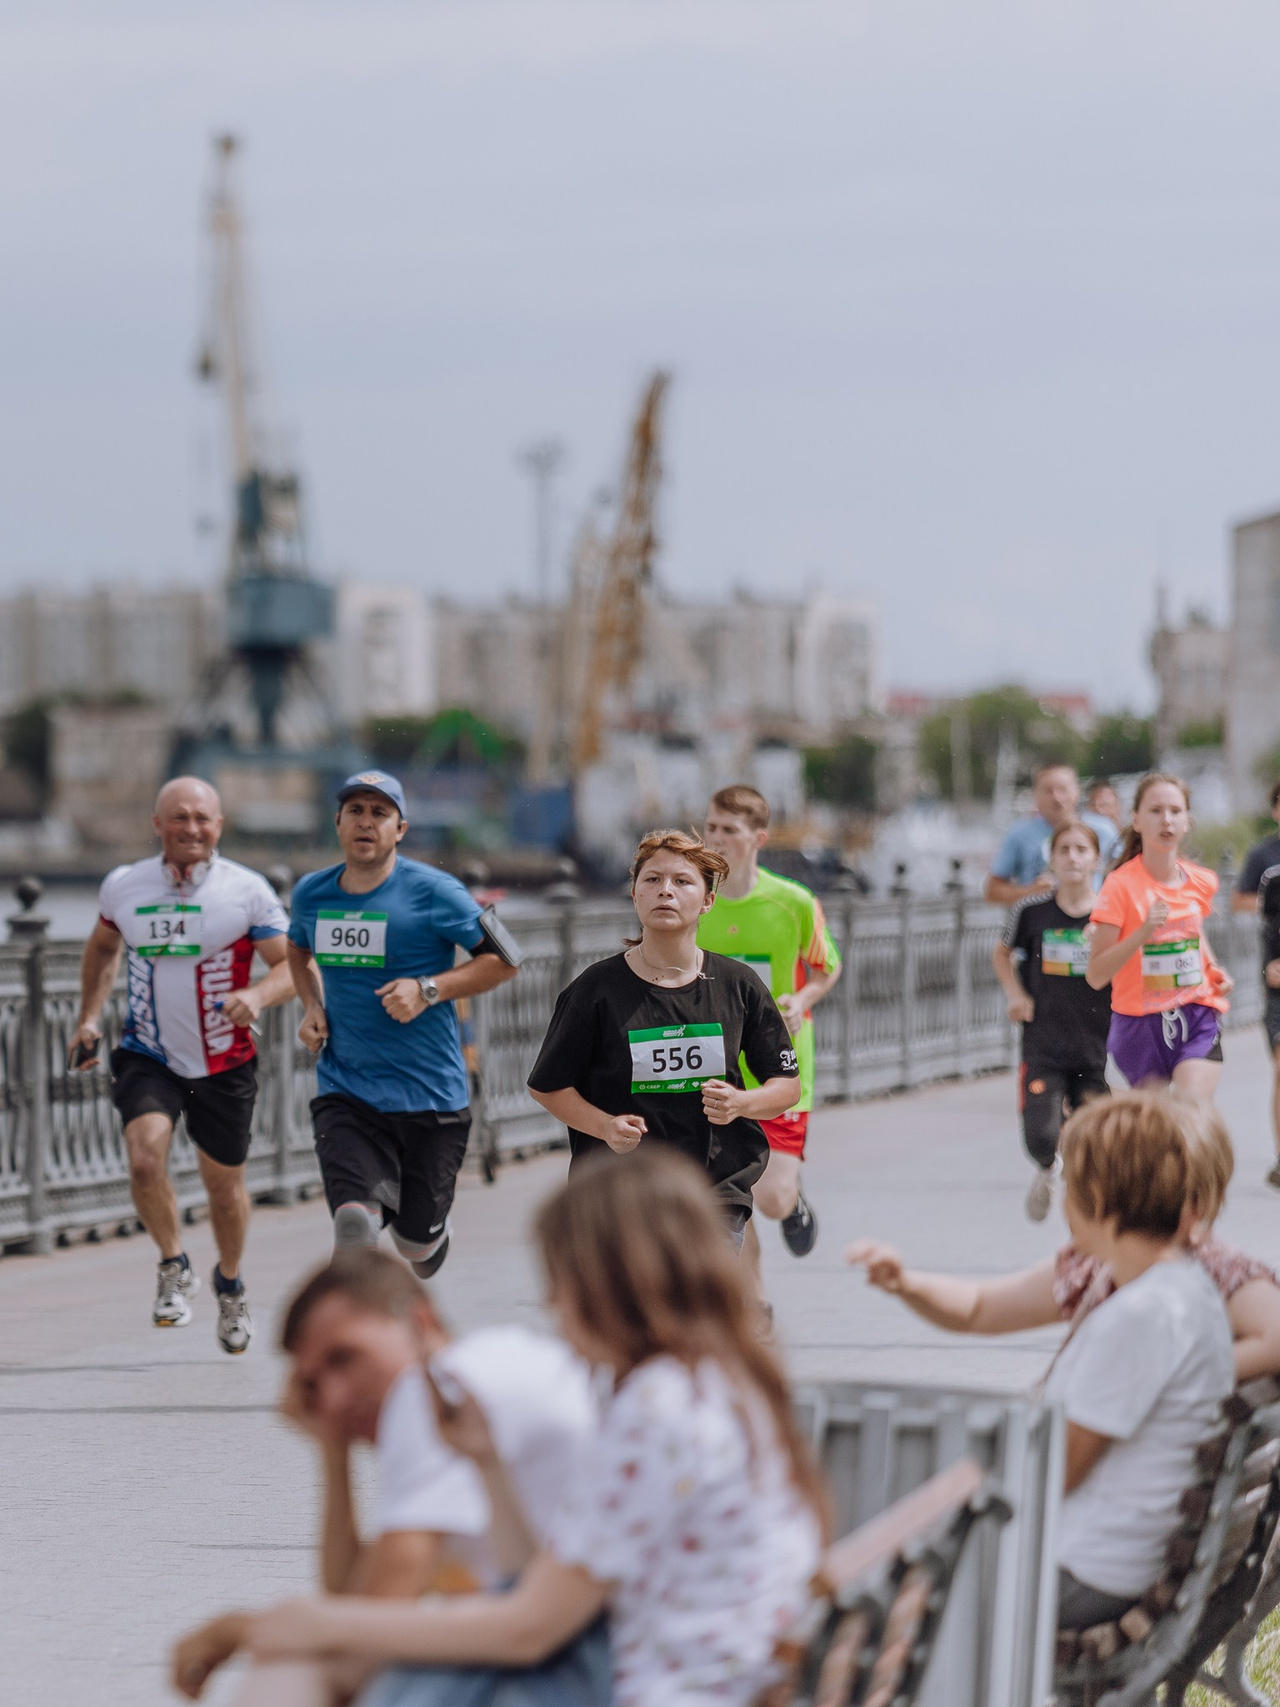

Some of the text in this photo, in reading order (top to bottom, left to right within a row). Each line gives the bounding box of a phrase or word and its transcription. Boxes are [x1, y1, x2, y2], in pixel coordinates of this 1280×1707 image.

[149, 920, 186, 939] 134
[331, 927, 370, 948] 960
[201, 949, 235, 1057] RUSSIA
[652, 1045, 703, 1074] 556
